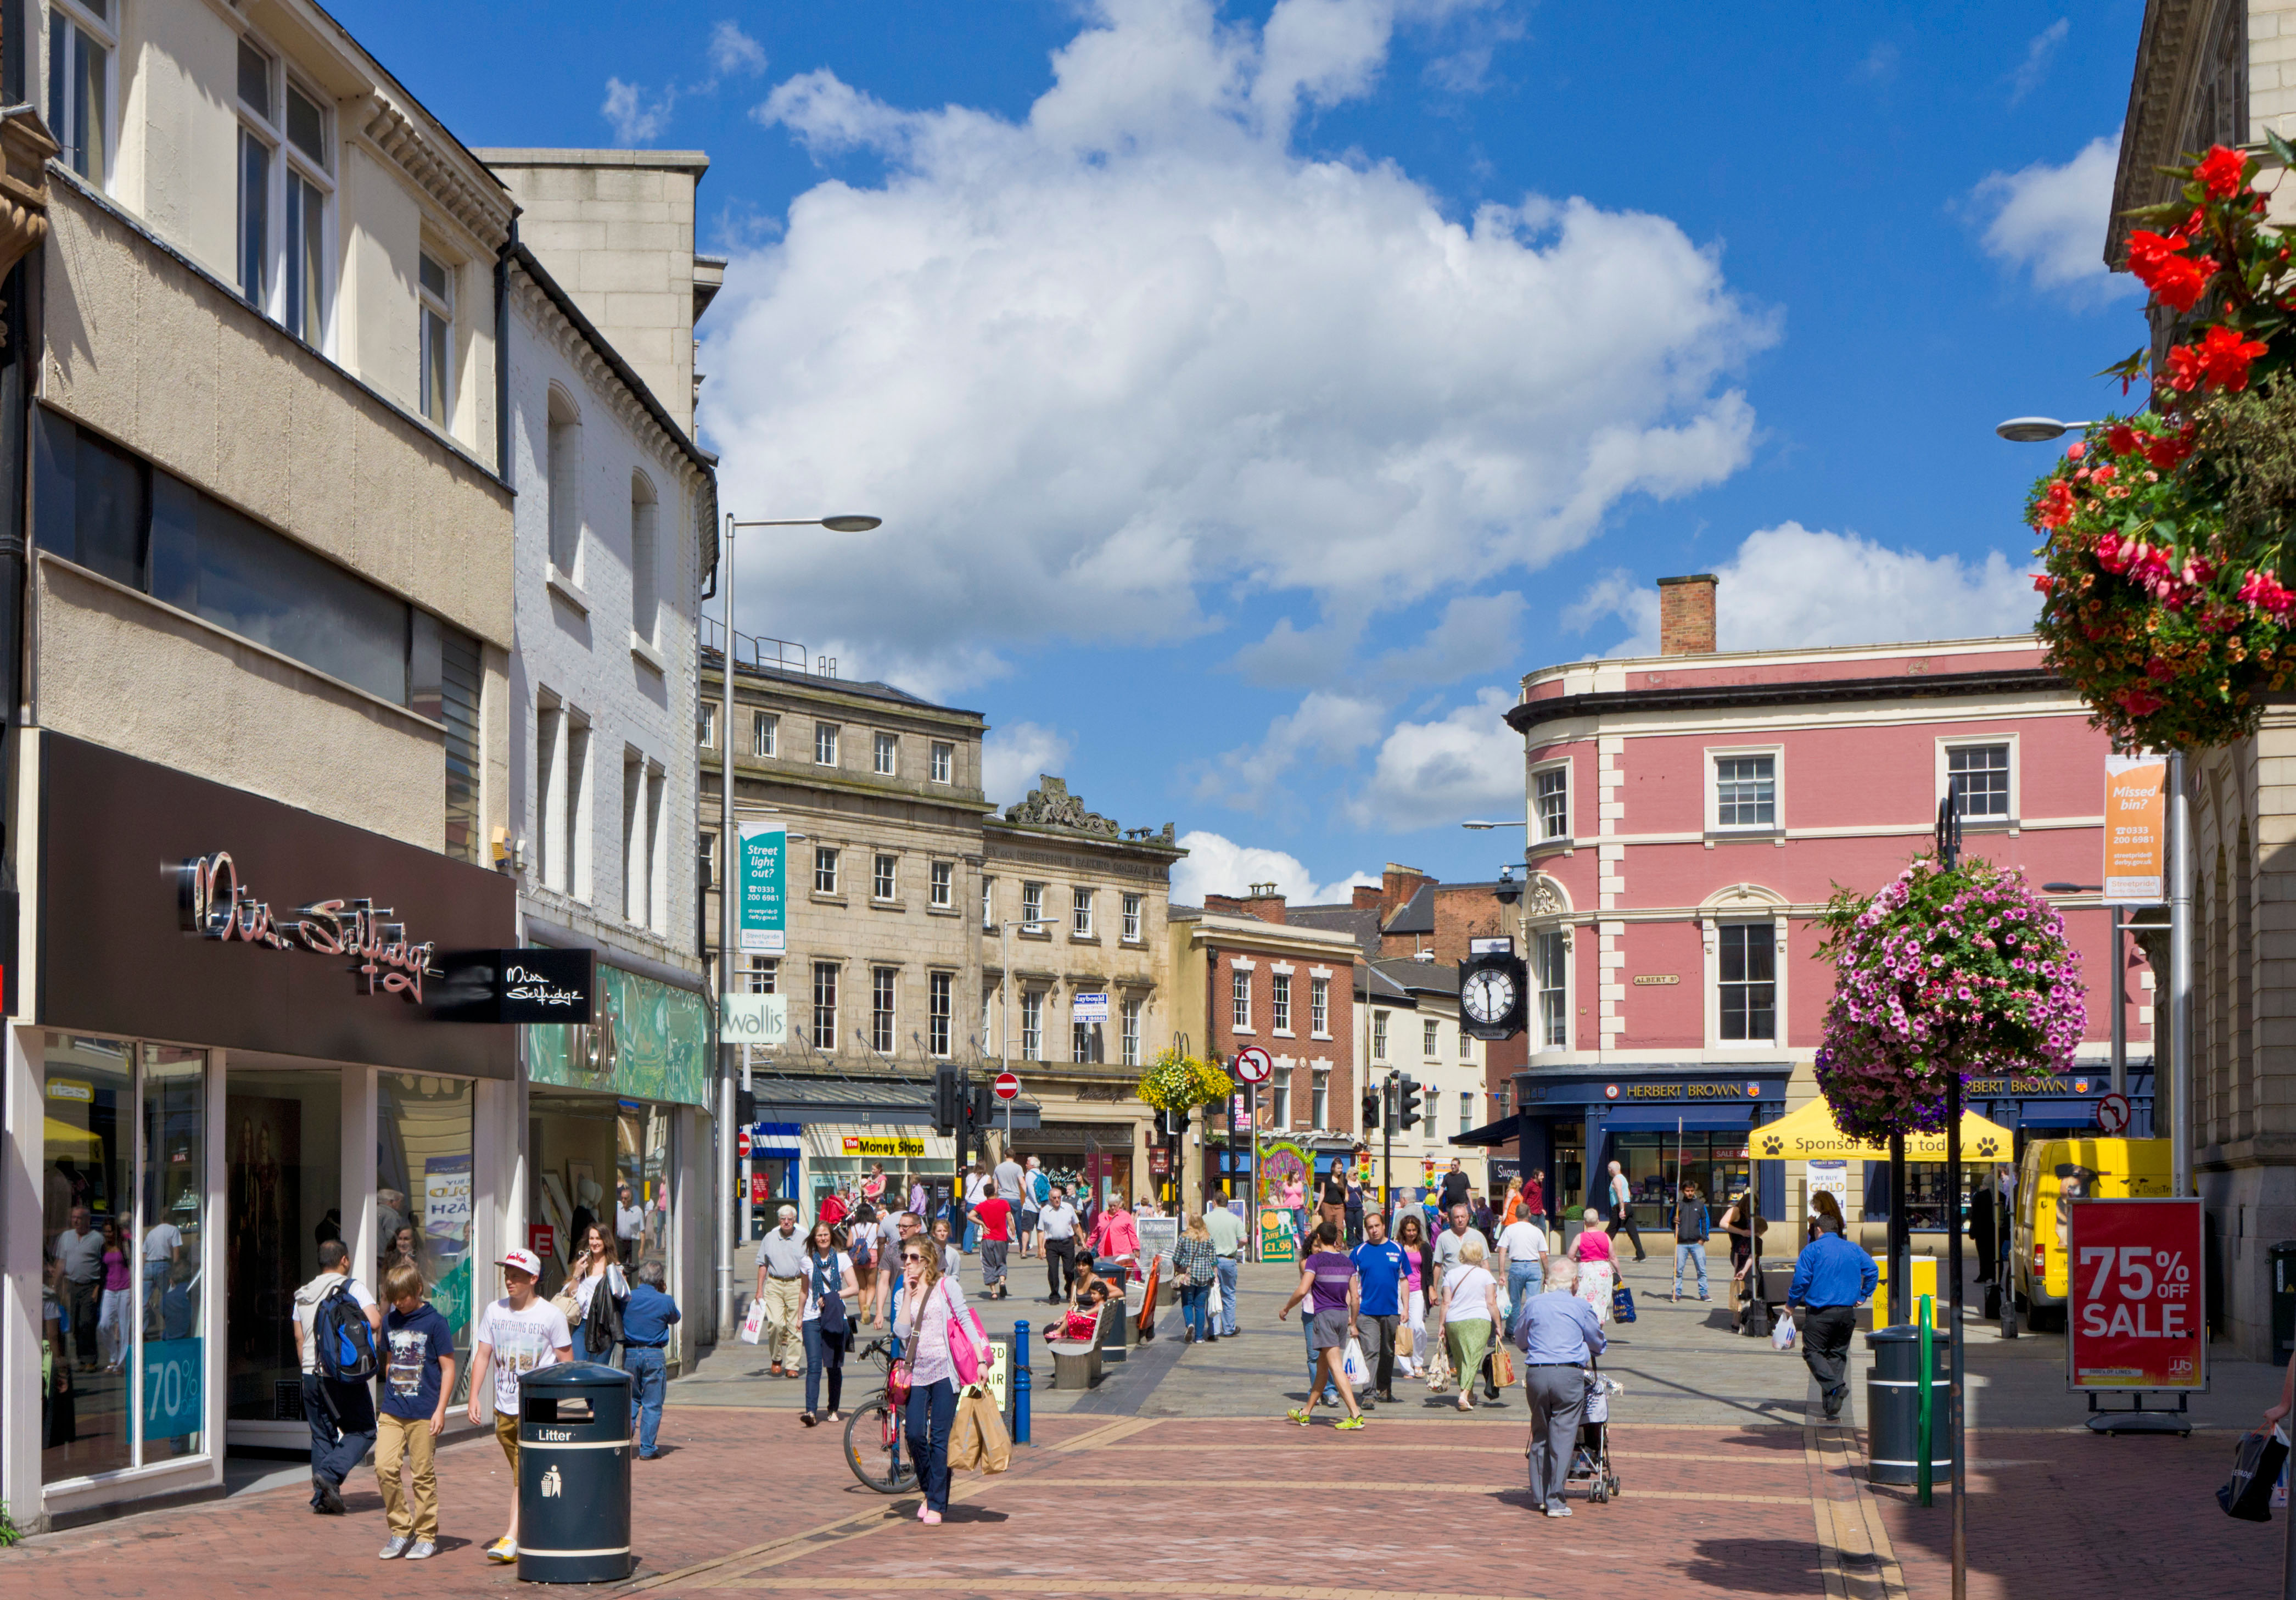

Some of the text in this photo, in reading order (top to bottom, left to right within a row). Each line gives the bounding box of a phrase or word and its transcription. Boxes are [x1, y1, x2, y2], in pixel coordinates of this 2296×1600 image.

[2113, 786, 2156, 798] Missed
[2120, 799, 2147, 810] bin?
[747, 845, 778, 855] Street
[751, 856, 774, 869] light
[983, 846, 998, 857] RBY
[1017, 850, 1072, 866] DERBYSHIRE
[1076, 858, 1110, 870] BANKING
[1113, 861, 1149, 876] COMPANY
[751, 869, 775, 878] out?
[194, 851, 445, 1004] Miss Selfridge
[507, 966, 549, 983] Miss
[506, 985, 584, 1006] Selfridge
[725, 1004, 782, 1034] wallis
[1627, 1084, 1740, 1097] HERBERT BROWN
[1967, 1079, 2067, 1092] RBERT BROWN
[845, 1139, 924, 1155] The Money Shop
[1796, 1138, 1860, 1153] Sponsor
[1882, 1138, 1912, 1153] dg
[1919, 1138, 1966, 1154] tody
[1810, 1182, 1845, 1193] GOLD
[2143, 1185, 2172, 1195] DogsTr
[1264, 1232, 1279, 1241] Any
[1264, 1242, 1292, 1252] £1.99
[2080, 1247, 2189, 1300] 75%
[2157, 1284, 2191, 1299] OFF
[491, 1318, 545, 1335] EVERYTHING GETS
[2082, 1304, 2186, 1338] SALE
[991, 1347, 1005, 1359] RD
[984, 1373, 1004, 1385] AIR
[181, 1397, 197, 1415] OFF
[539, 1429, 572, 1442] Litter
